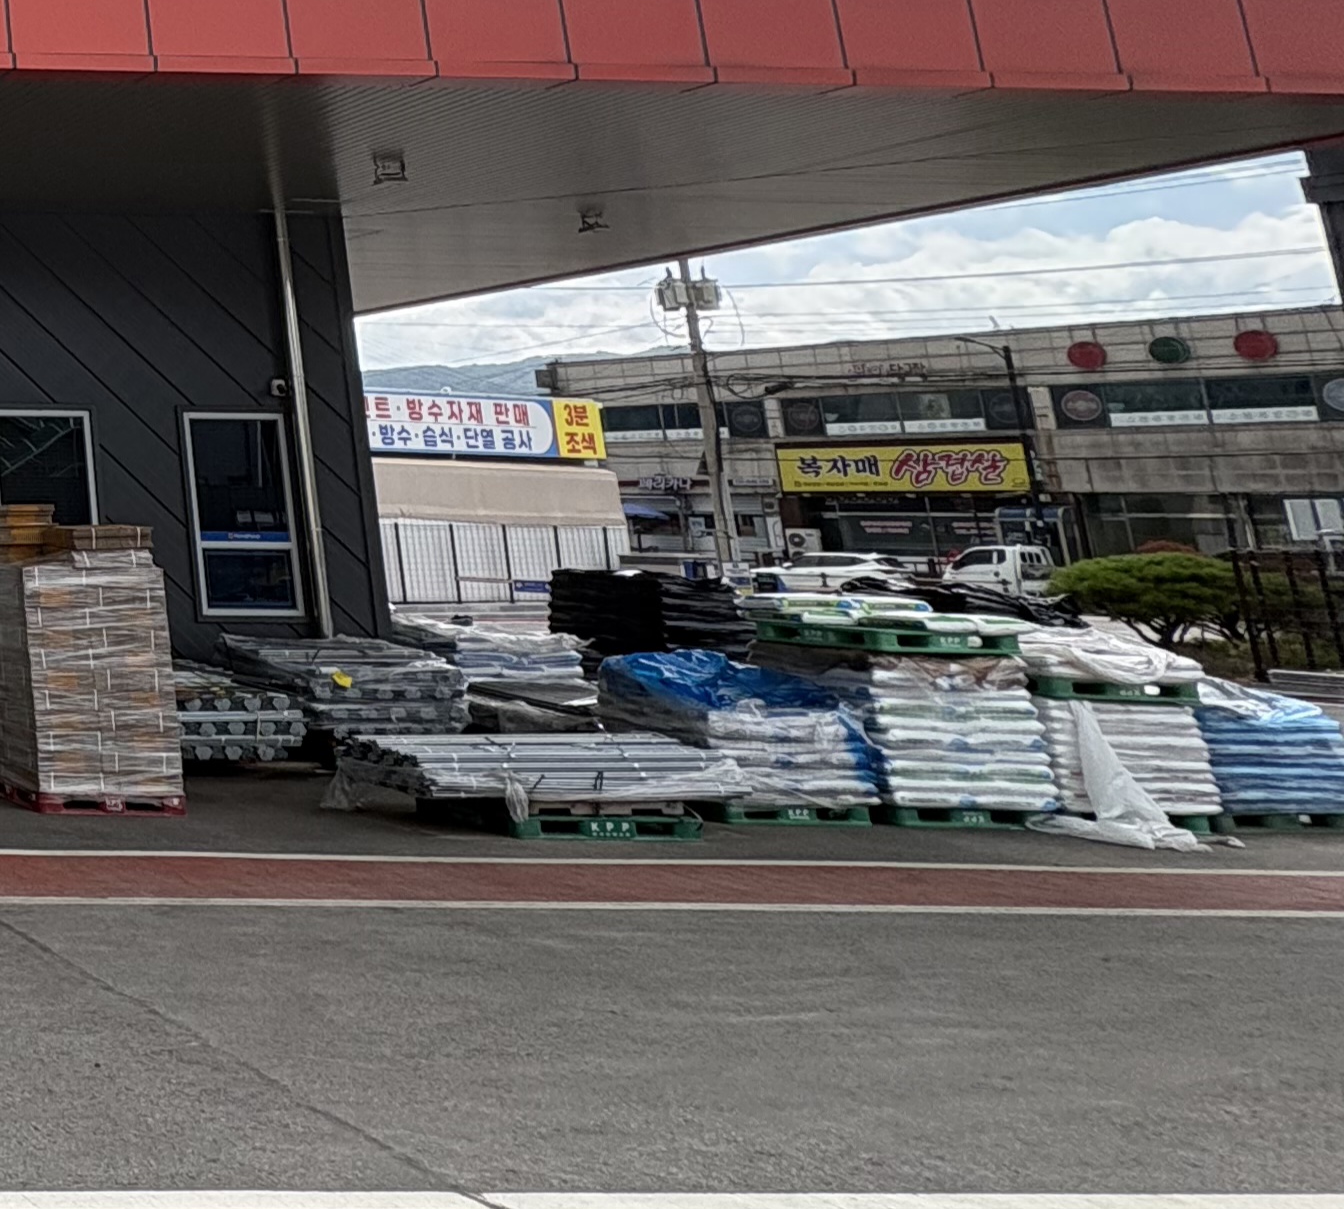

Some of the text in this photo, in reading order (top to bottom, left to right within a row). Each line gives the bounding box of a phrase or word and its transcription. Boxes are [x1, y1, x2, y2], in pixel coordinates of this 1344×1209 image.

[493, 402, 531, 427] 판매
[564, 404, 591, 427] 3분
[501, 429, 534, 451] 공사
[565, 432, 599, 456] 조색
[797, 448, 1009, 488] 복자매 삼겹살
